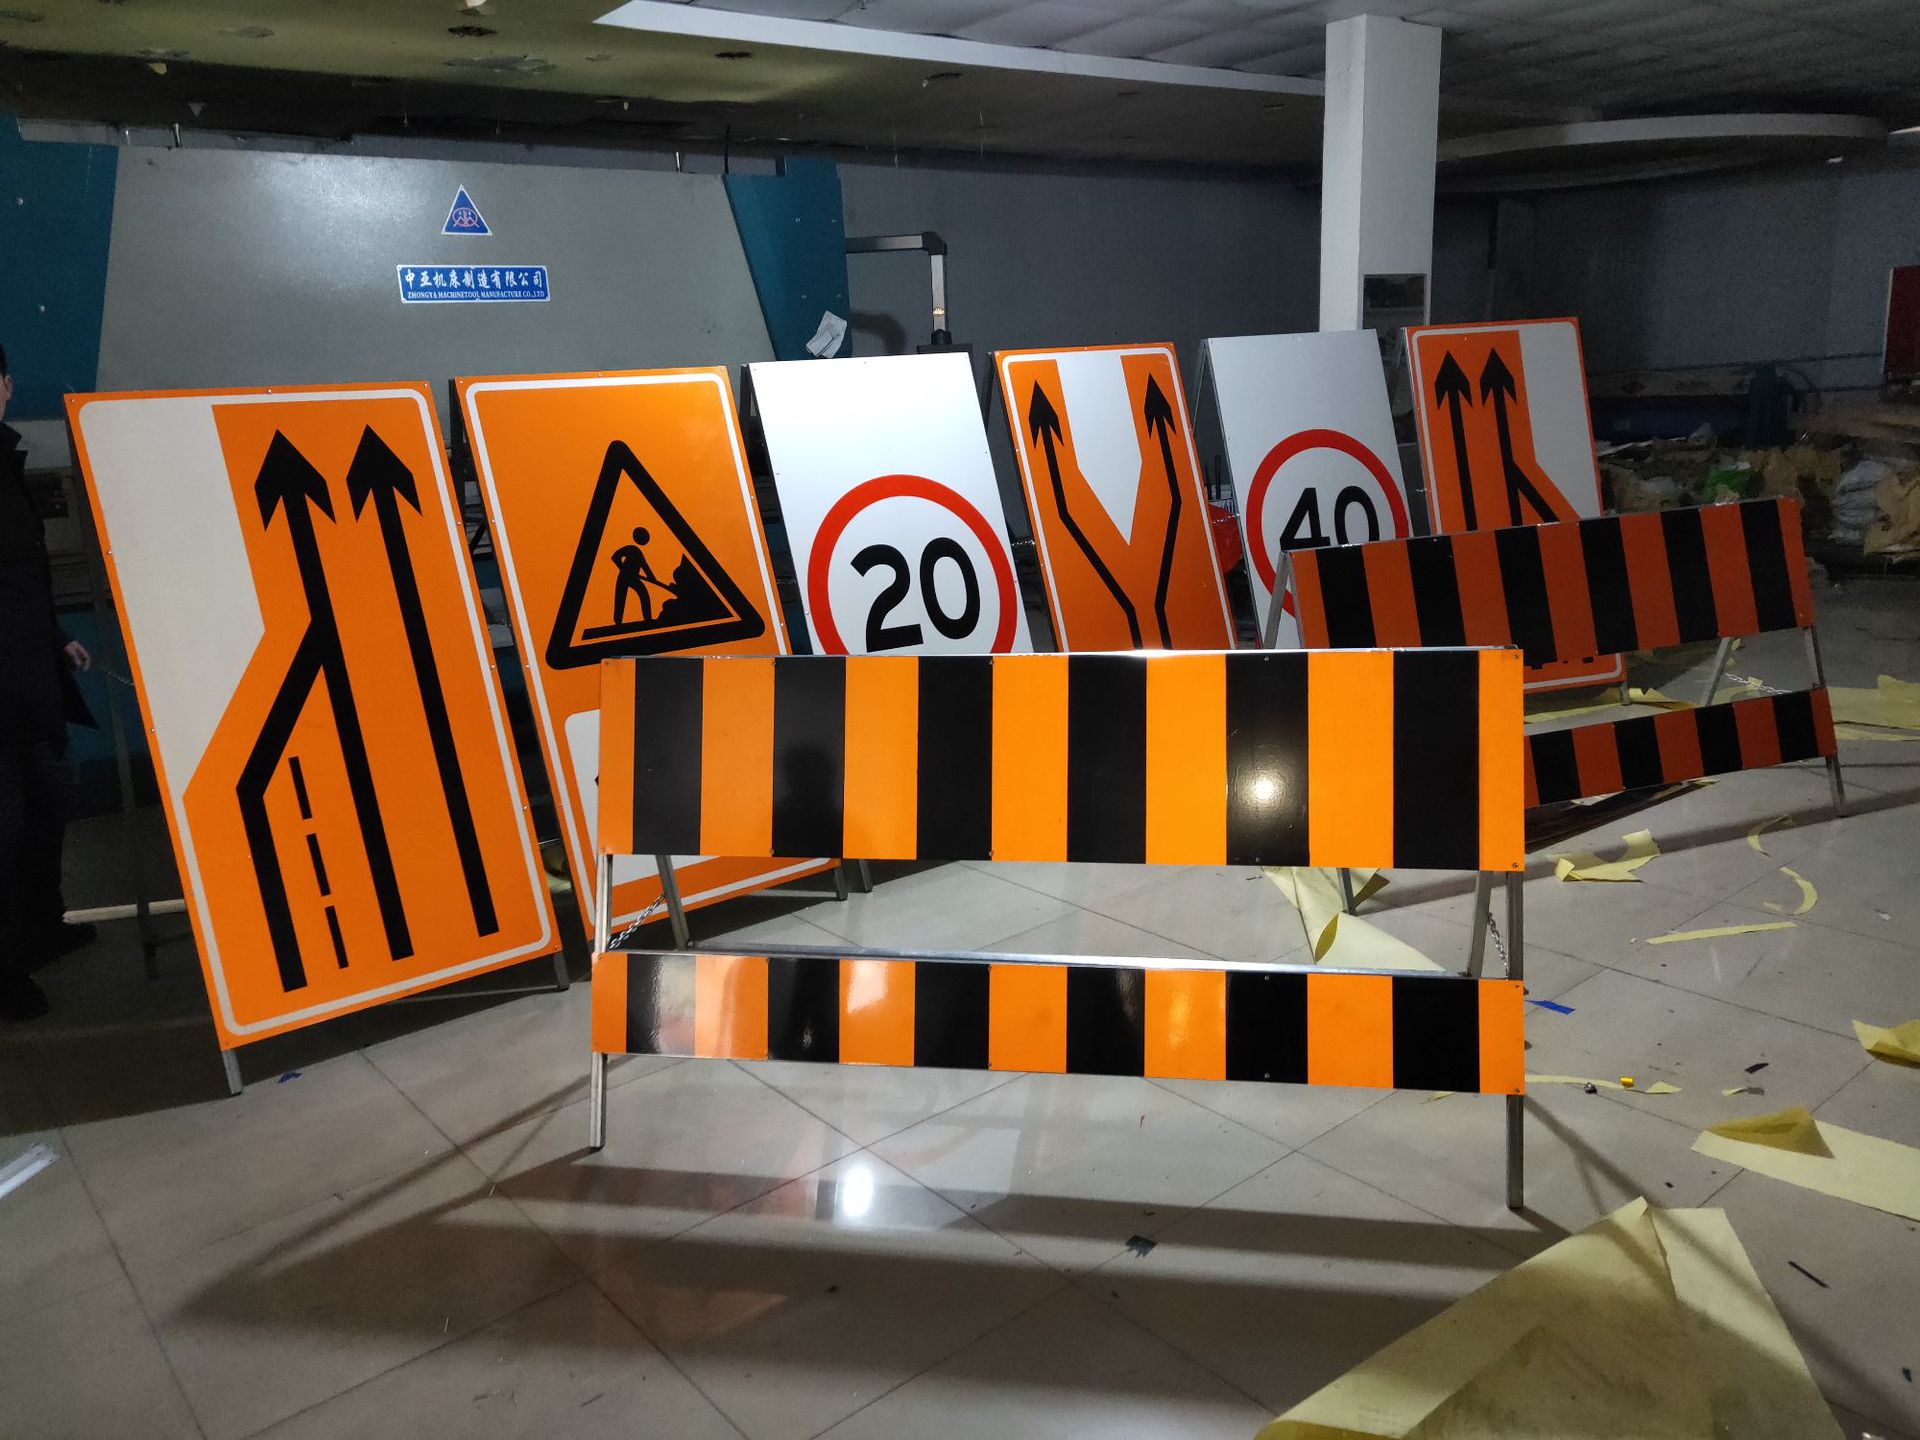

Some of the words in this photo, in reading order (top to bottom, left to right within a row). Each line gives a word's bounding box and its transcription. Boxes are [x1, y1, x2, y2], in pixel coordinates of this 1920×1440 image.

[407, 291, 437, 299] ZHONGYA
[480, 290, 521, 298] MANUFACTURE
[1280, 485, 1380, 551] 40
[850, 537, 981, 653] 20
